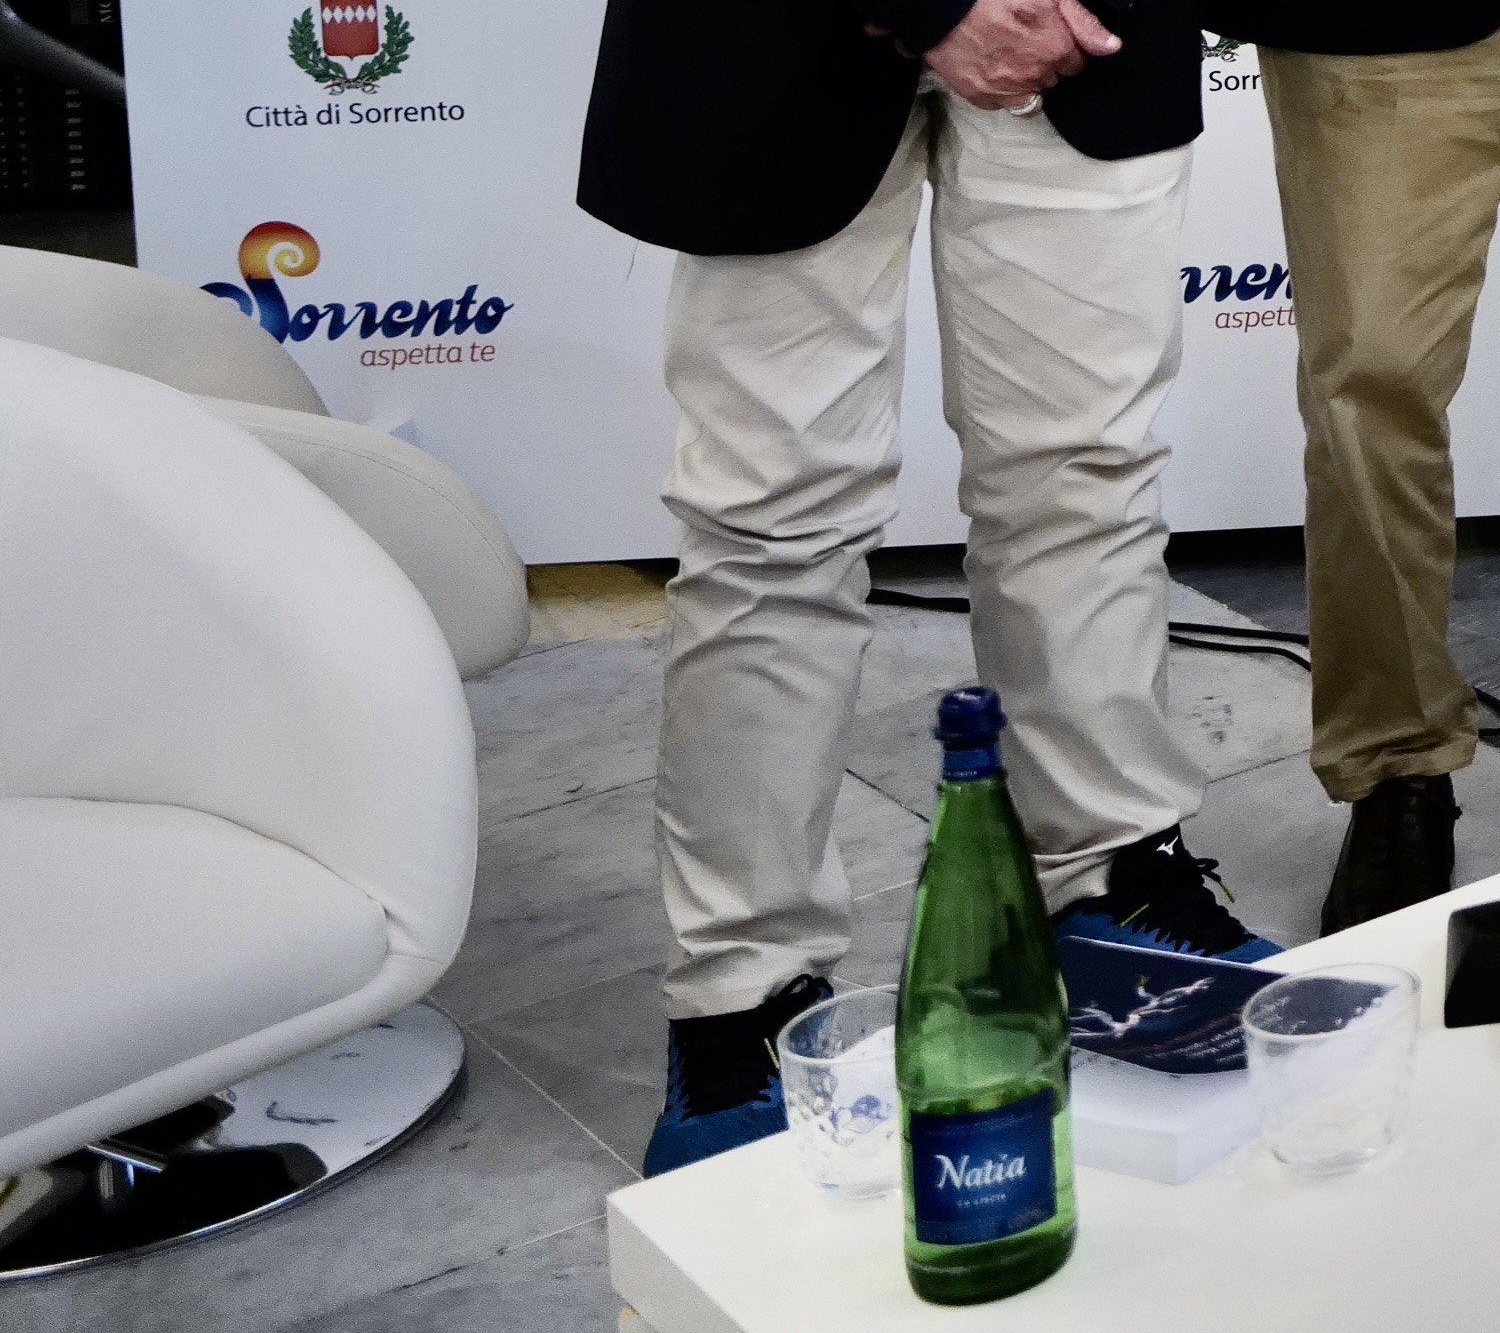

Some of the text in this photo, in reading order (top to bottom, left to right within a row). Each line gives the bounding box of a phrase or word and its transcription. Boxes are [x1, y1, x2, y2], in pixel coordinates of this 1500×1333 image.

[1209, 70, 1261, 92] Sorr
[246, 102, 464, 127] Città di Sorrento
[1215, 304, 1296, 333] aspett
[360, 342, 495, 370] aspetta te
